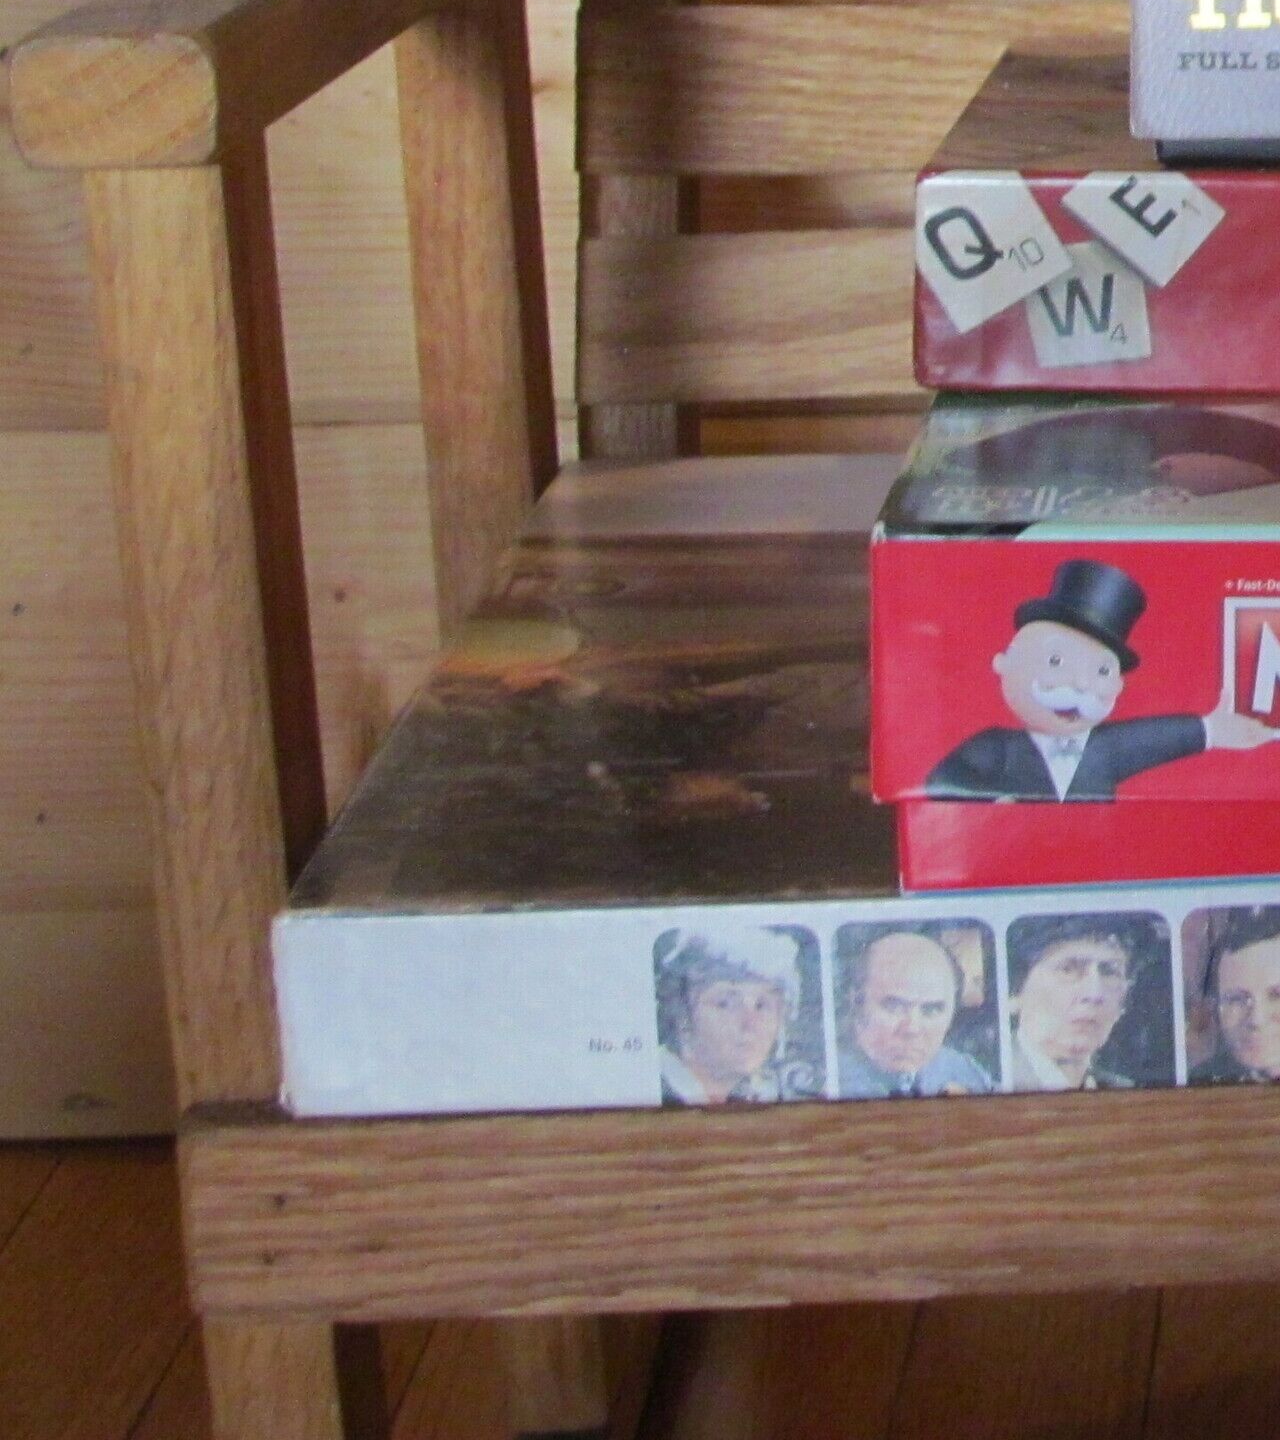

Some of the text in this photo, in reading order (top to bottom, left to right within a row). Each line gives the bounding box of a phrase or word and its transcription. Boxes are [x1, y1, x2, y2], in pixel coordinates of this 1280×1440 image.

[1177, 50, 1258, 71] FULL
[1109, 174, 1178, 239] E
[924, 206, 1004, 281] Q
[1036, 273, 1115, 337] W
